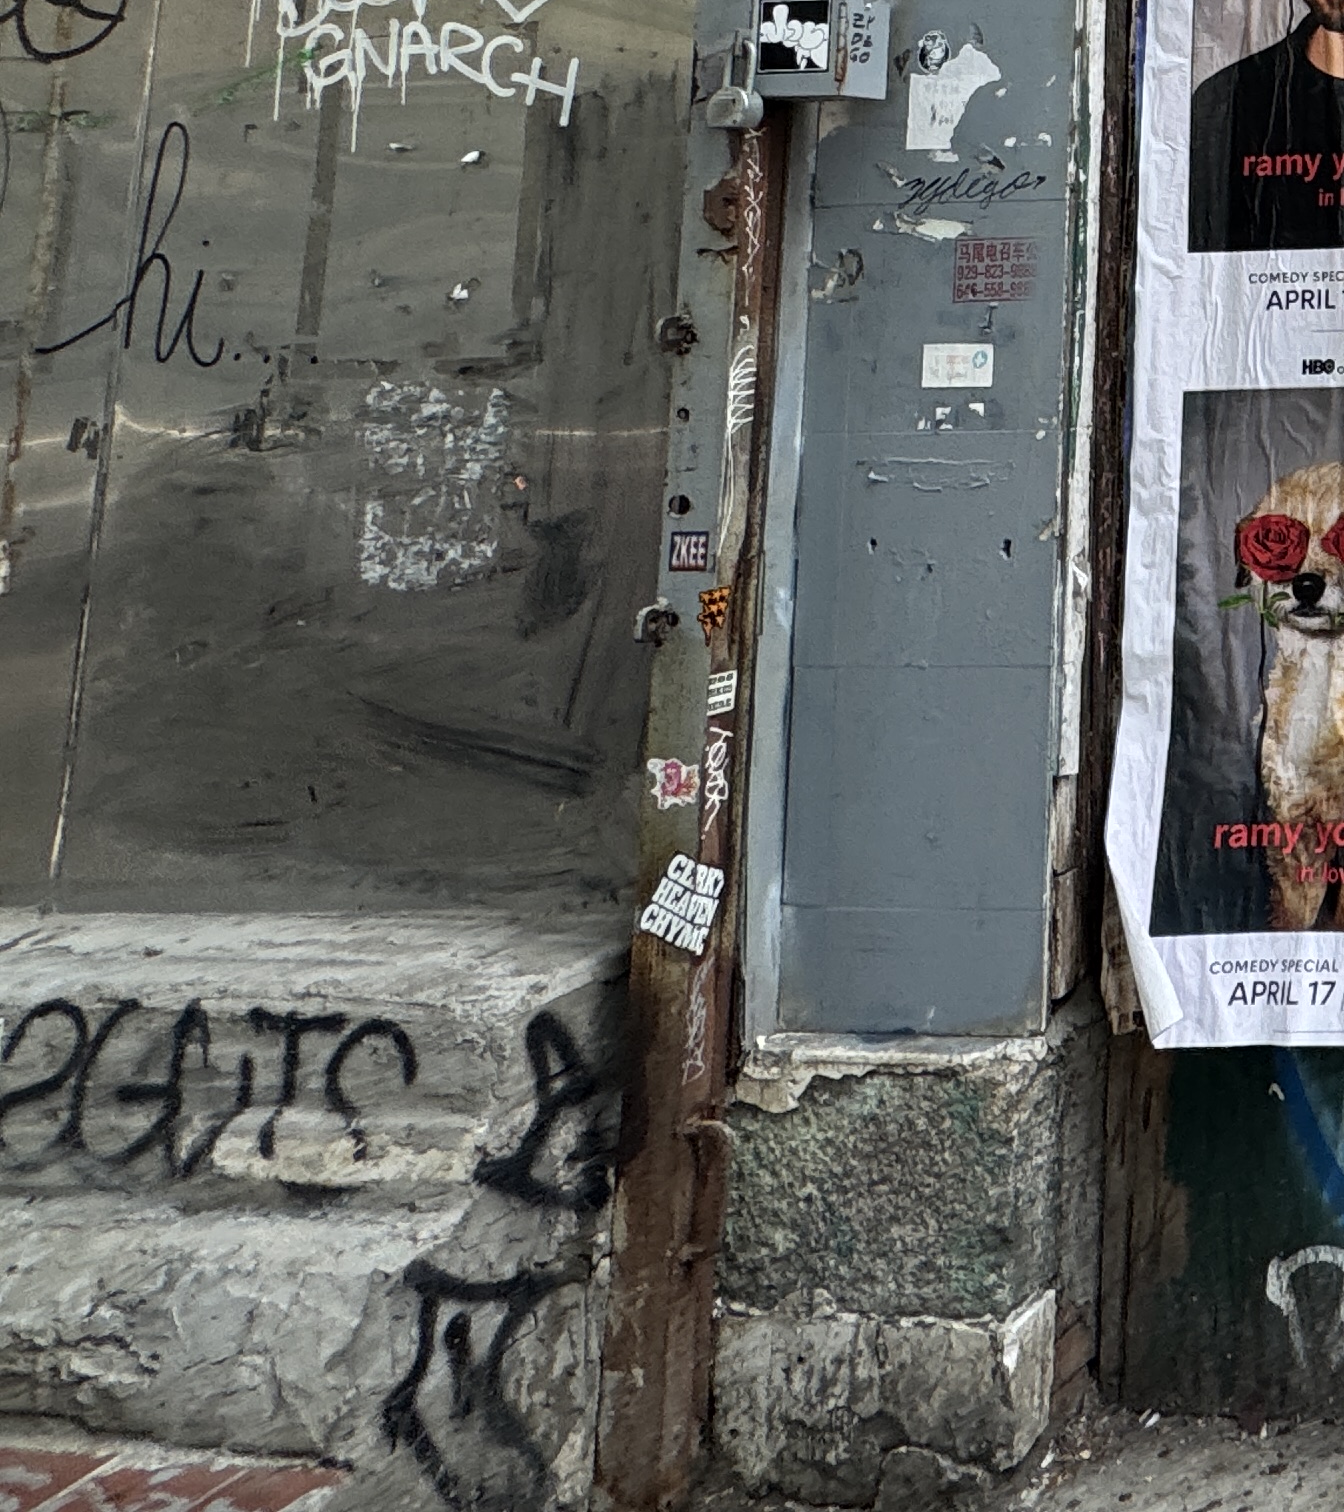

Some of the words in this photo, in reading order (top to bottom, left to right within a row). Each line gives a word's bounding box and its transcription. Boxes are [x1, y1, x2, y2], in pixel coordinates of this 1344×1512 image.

[1243, 152, 1322, 183] ramy
[1319, 189, 1333, 206] in
[1248, 270, 1310, 284] COMEDY
[1266, 289, 1336, 311] APRIL
[1301, 358, 1335, 375] HBO
[671, 534, 708, 568] ZKEE
[1213, 822, 1304, 854] ramy
[1296, 864, 1314, 884] in
[1209, 961, 1279, 975] COMEDY
[1281, 958, 1339, 973] SPECIAL
[1227, 981, 1299, 1007] APRIL
[1307, 981, 1337, 1006] 17
